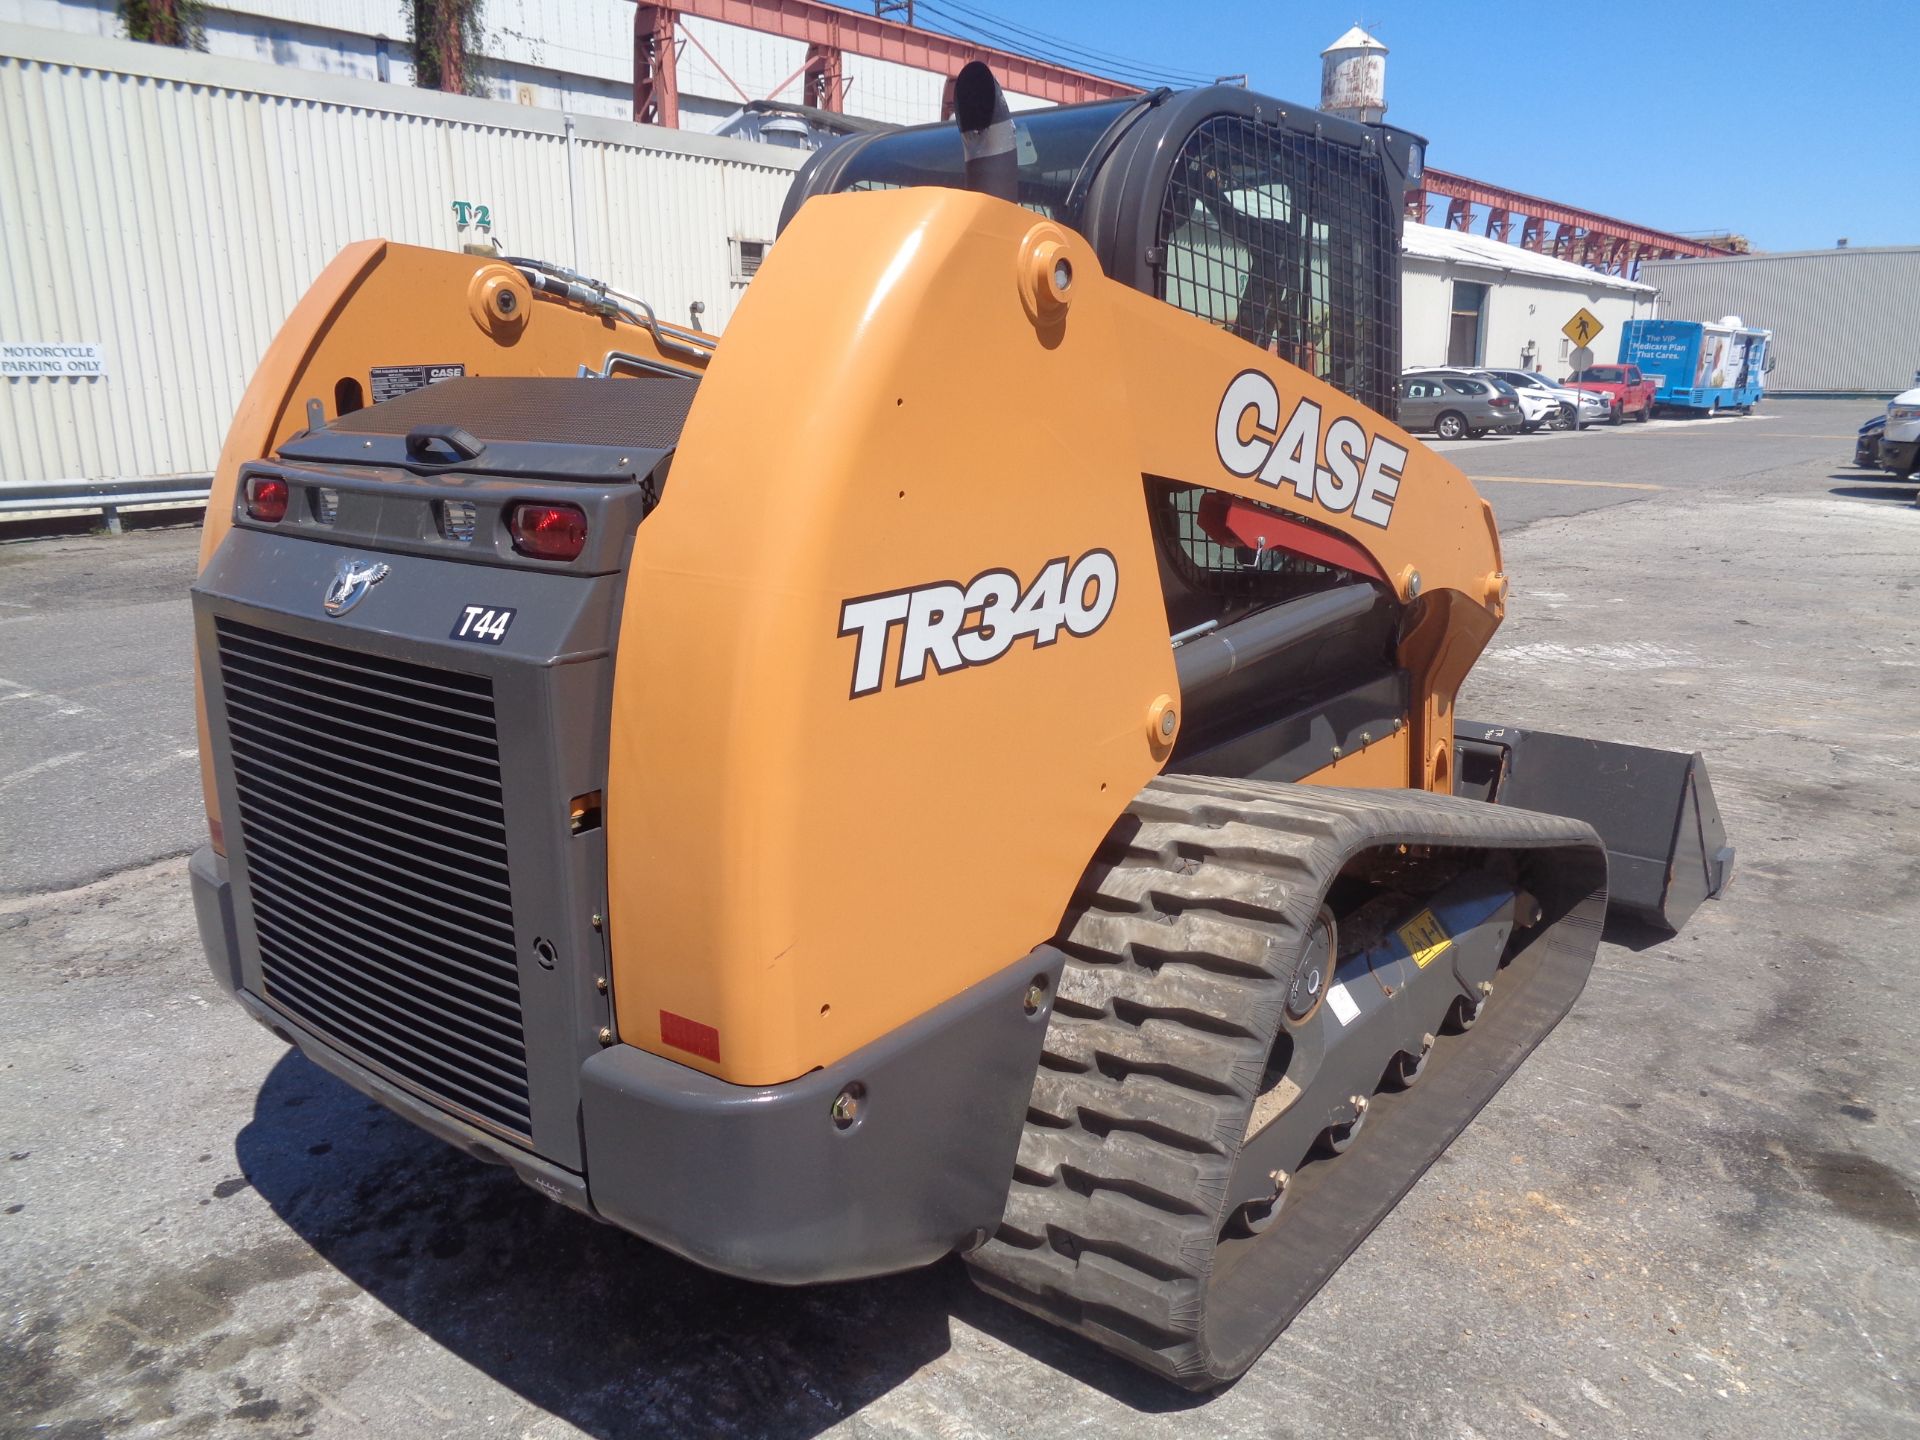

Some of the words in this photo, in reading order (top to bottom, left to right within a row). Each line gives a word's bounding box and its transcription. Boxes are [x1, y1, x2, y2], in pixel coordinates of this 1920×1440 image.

[452, 201, 491, 226] T2
[3, 347, 95, 357] MOTORCYCLE
[2, 361, 62, 371] PARKING
[67, 361, 101, 371] ONLY
[430, 368, 462, 378] CASE
[1215, 368, 1409, 530] CASE
[459, 606, 511, 640] T44
[837, 547, 1119, 700] TR340
